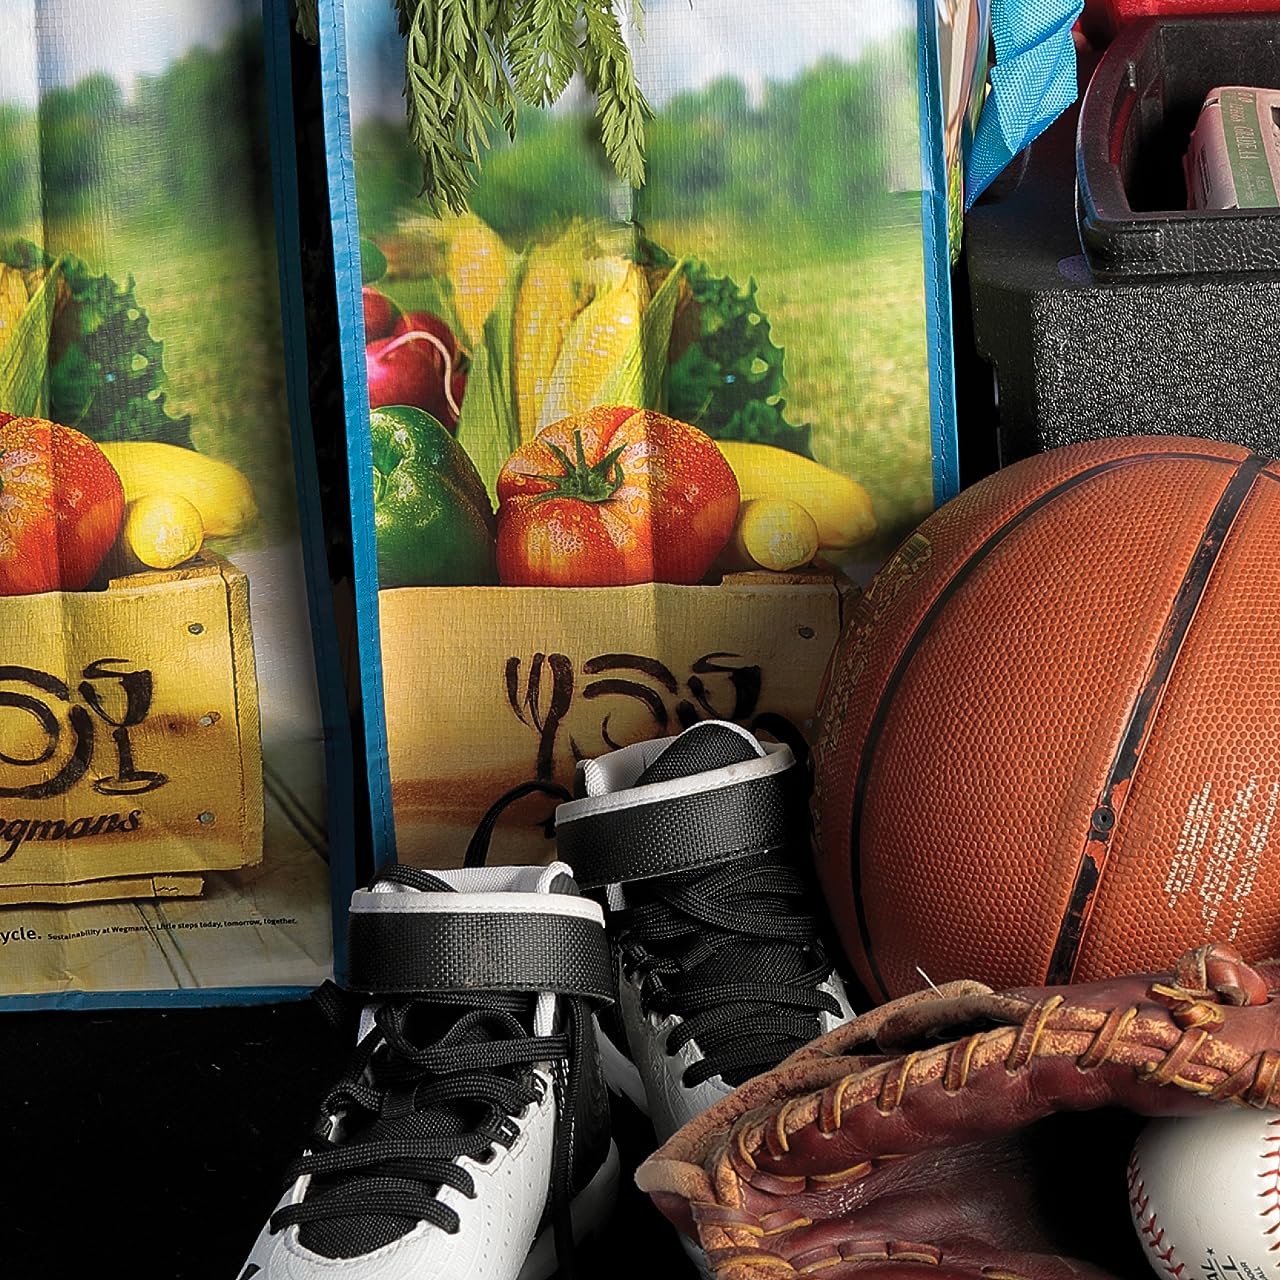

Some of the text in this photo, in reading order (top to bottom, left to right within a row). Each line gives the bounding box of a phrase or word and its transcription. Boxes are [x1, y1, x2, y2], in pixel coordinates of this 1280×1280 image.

[0, 927, 42, 945] ycle.
[48, 927, 101, 940] Sustainability
[102, 926, 110, 934] at
[112, 924, 149, 934] Wegmans
[156, 922, 177, 930] Little
[178, 922, 198, 930] steps
[200, 920, 223, 929] today,
[224, 919, 262, 928] tomorrow,
